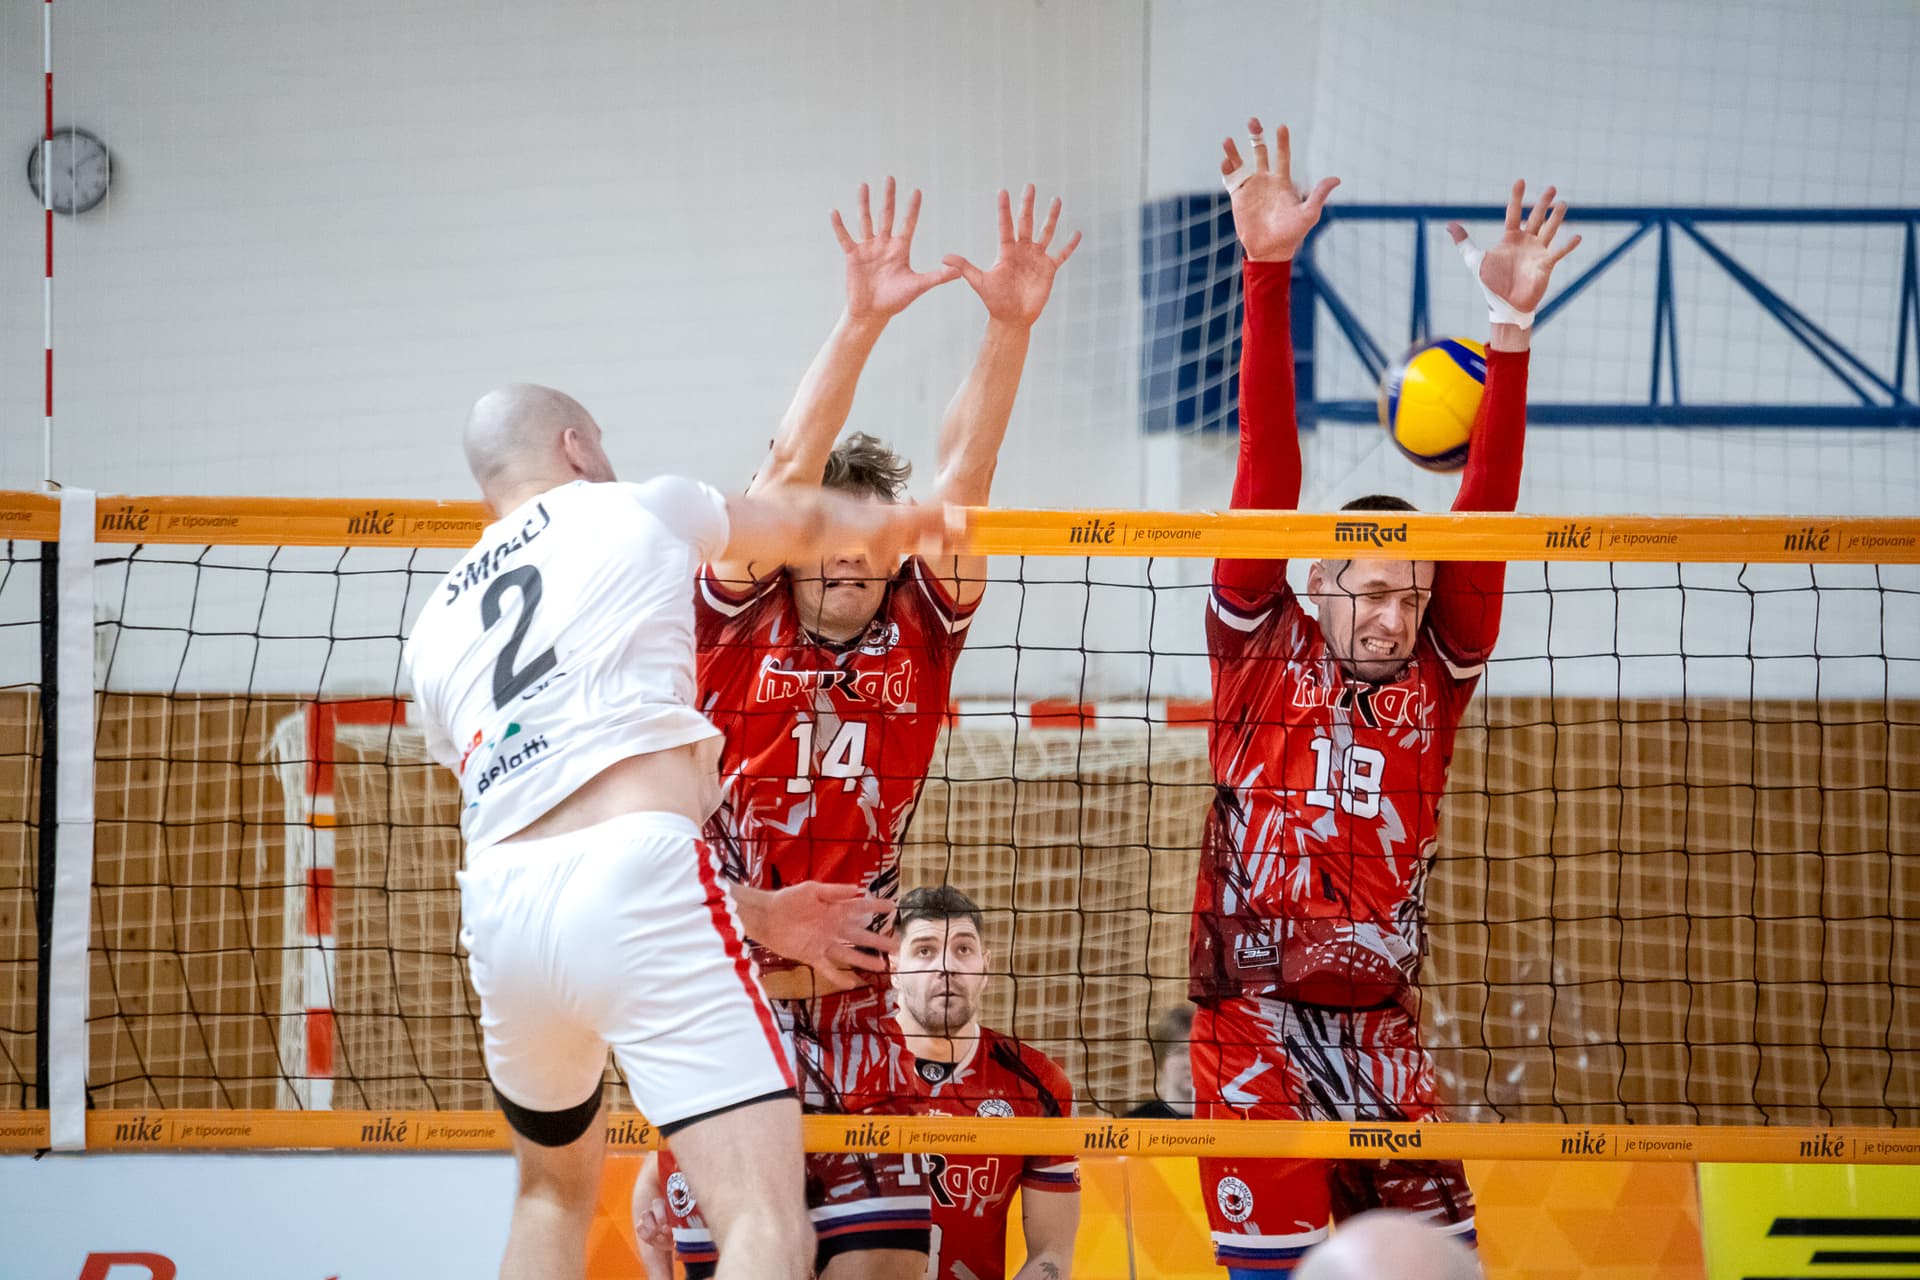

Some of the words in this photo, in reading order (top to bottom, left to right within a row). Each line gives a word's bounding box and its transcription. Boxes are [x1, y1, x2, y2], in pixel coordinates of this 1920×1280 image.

[0, 511, 32, 522] vanie
[101, 506, 149, 531] niké
[168, 514, 181, 528] je
[182, 514, 239, 528] tipovanie
[347, 509, 394, 534] niké
[412, 518, 425, 532] je
[426, 518, 482, 532] tipovanie
[1069, 519, 1116, 544] niké
[1133, 528, 1144, 541] je
[1145, 527, 1201, 541] tipovanie
[1545, 523, 1592, 548] niké
[1609, 532, 1621, 546] je
[1623, 532, 1678, 546] tipovanie
[1784, 527, 1830, 551] niké
[1848, 535, 1859, 548] je
[1861, 535, 1916, 548] tipovanie
[481, 565, 557, 711] 2
[786, 721, 867, 793] 14
[1305, 737, 1385, 819] 18
[0, 1124, 45, 1138] ovanie
[115, 1116, 162, 1141] niké
[181, 1125, 193, 1139] je
[195, 1125, 252, 1138] tipovanie
[361, 1117, 407, 1143] niké
[425, 1126, 437, 1139] je
[439, 1125, 495, 1139] tipovanie
[605, 1119, 649, 1144] niké
[845, 1121, 890, 1147] niké
[909, 1131, 920, 1144] je
[922, 1131, 977, 1144] tipovanie
[1084, 1125, 1129, 1149] niké
[1148, 1134, 1159, 1147] je
[1161, 1134, 1216, 1147] tipovanie
[1561, 1131, 1606, 1155] niké
[1624, 1139, 1636, 1153] je
[1638, 1139, 1693, 1152] tipovanie
[1799, 1133, 1845, 1157] niké
[1864, 1141, 1874, 1155] je
[1877, 1141, 1920, 1155] tipovan
[929, 1152, 999, 1207] Rad
